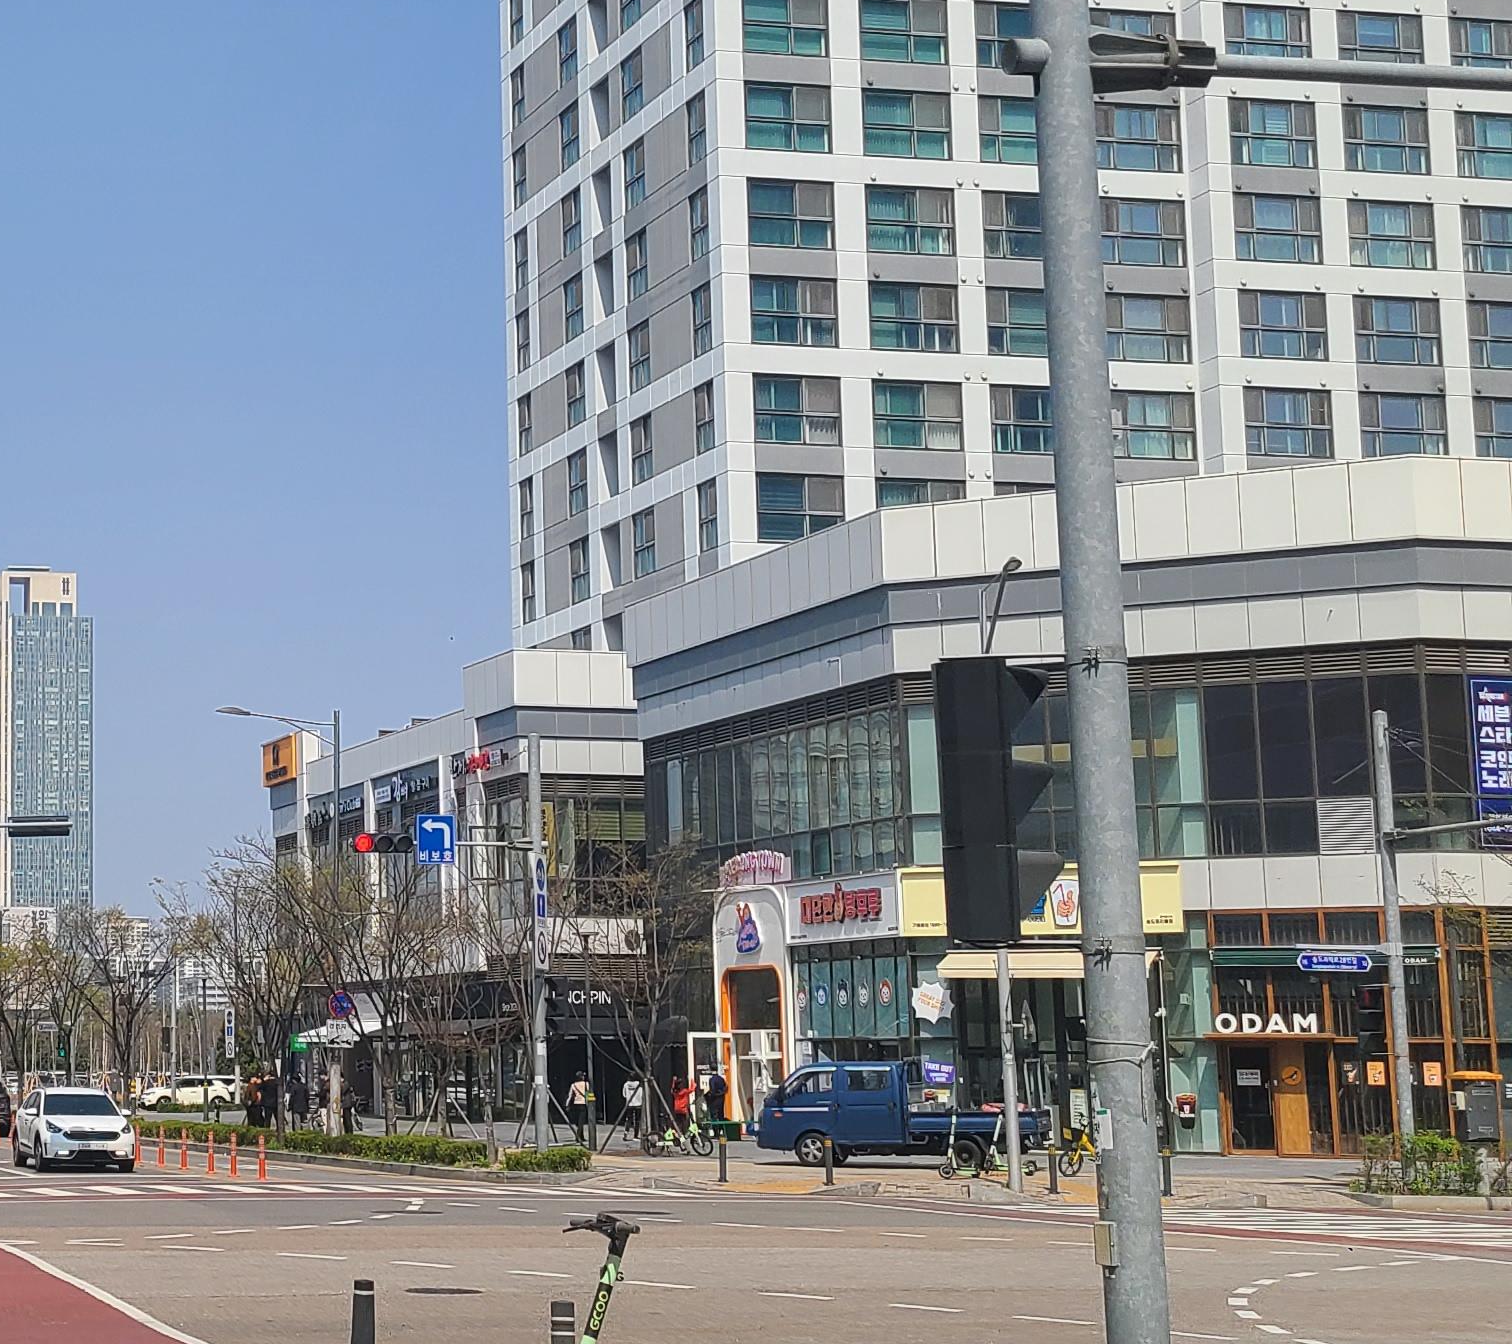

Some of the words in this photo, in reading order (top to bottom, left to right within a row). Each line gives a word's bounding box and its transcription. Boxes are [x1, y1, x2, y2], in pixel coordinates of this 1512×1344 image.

[1479, 726, 1512, 744] 스타
[419, 848, 454, 862] 비보호
[552, 990, 612, 1005] CHPIN
[1215, 1012, 1318, 1034] ODAM
[589, 1290, 609, 1331] GCOO
